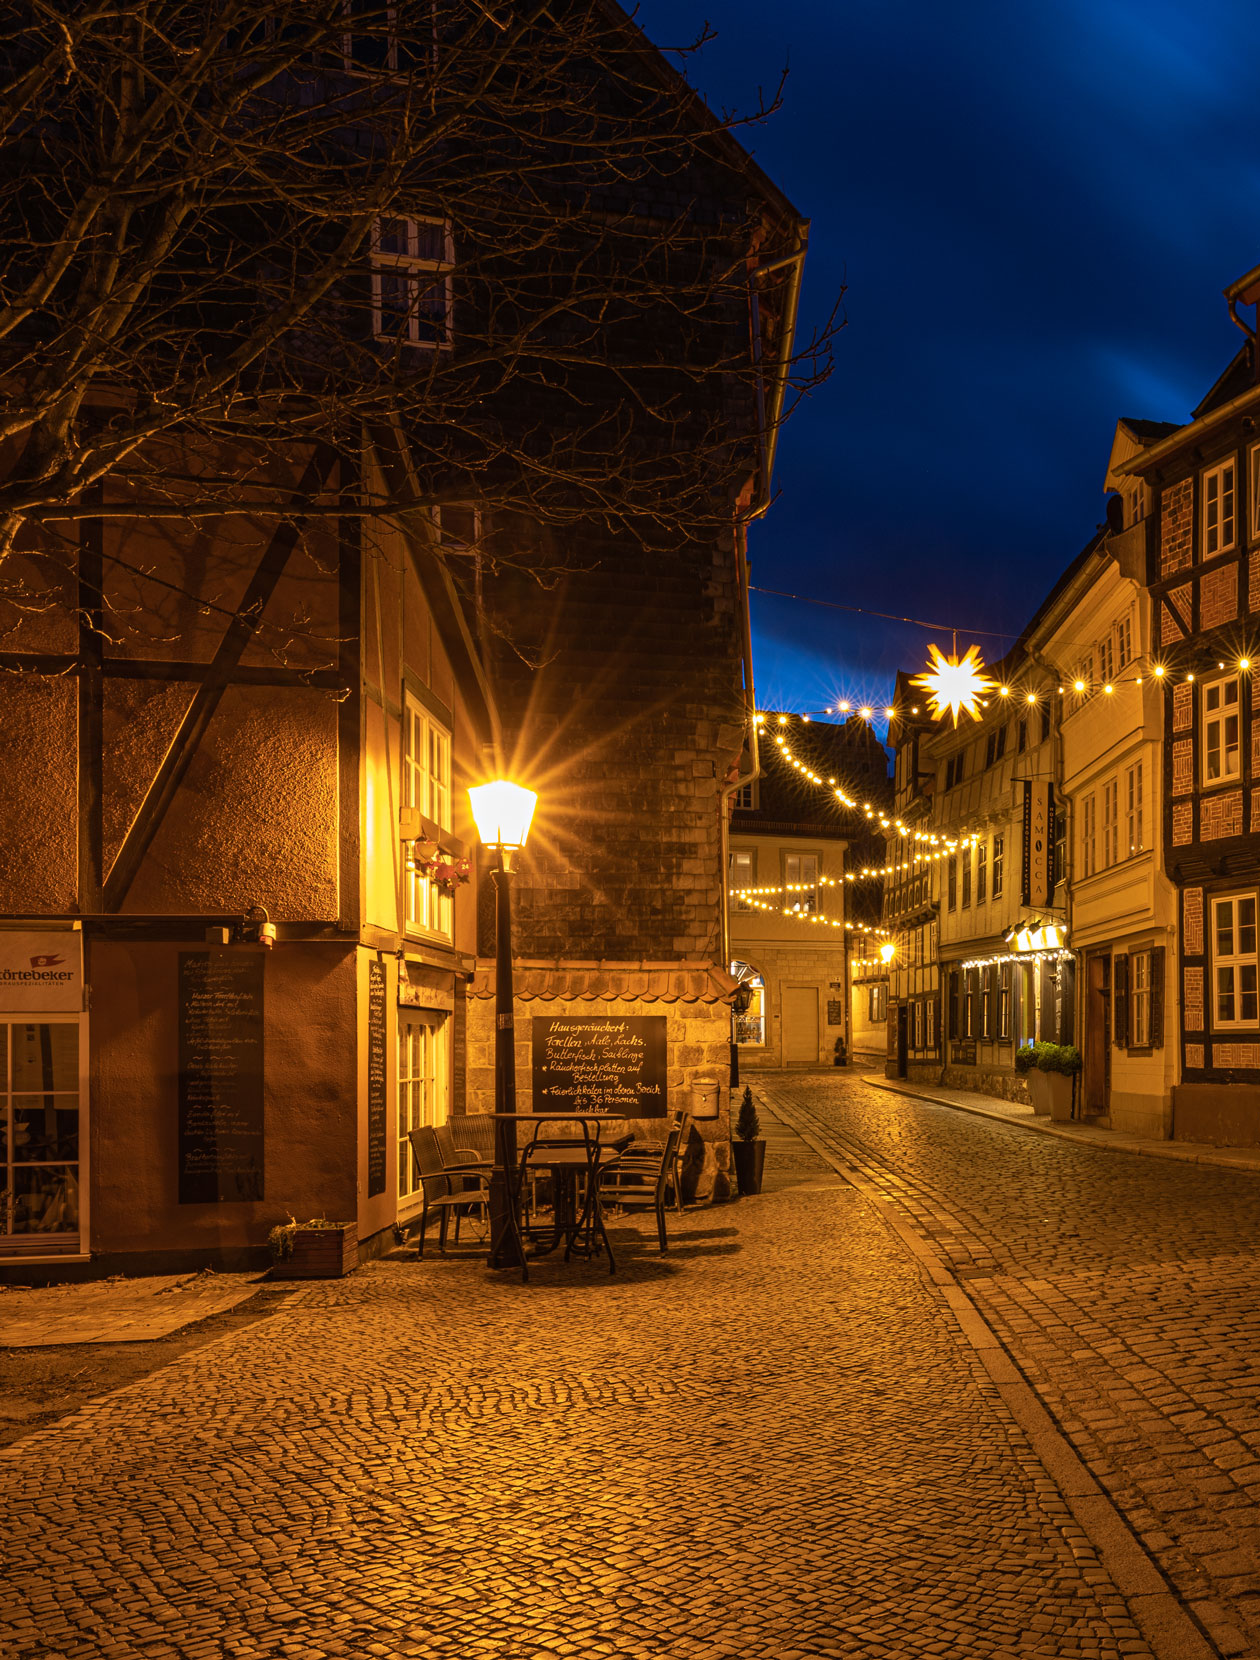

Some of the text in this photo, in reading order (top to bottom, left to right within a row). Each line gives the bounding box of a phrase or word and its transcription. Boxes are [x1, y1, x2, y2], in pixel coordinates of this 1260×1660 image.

[627, 1061, 644, 1074] auf
[572, 1072, 619, 1085] Bestellung
[590, 1096, 604, 1104] 36
[604, 1094, 640, 1104] Personen
